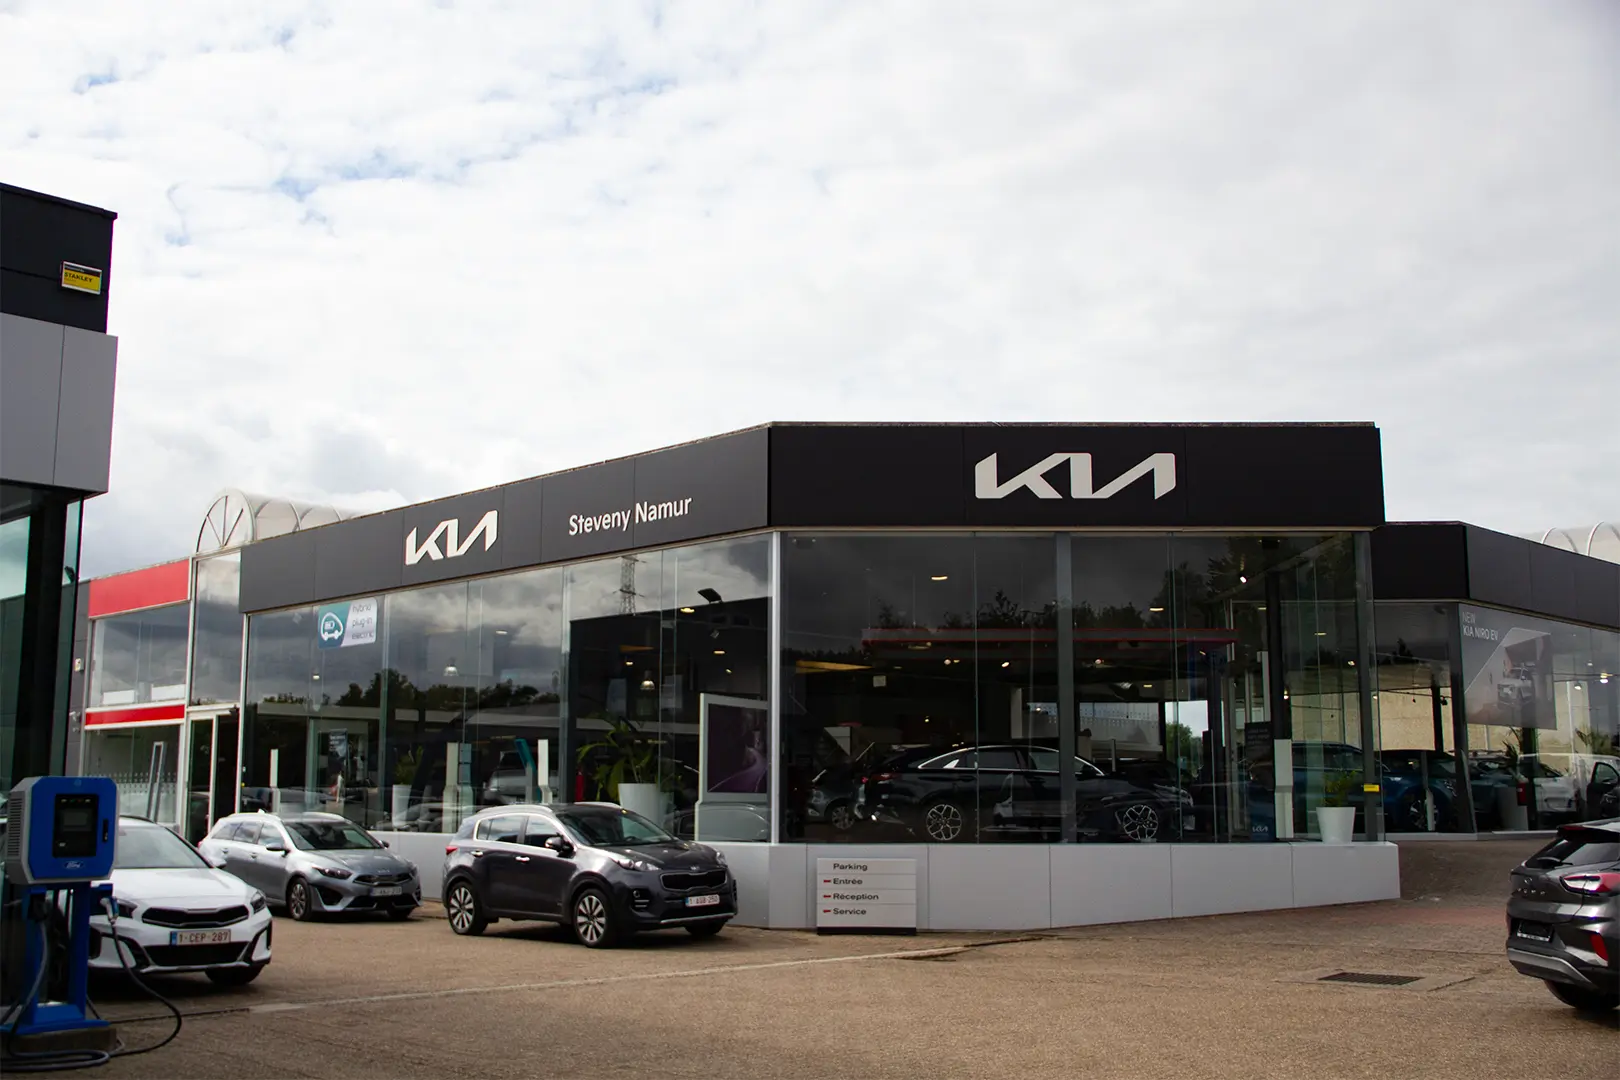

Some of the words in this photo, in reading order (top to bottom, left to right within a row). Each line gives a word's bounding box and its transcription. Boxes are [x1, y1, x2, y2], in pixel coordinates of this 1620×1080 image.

[64, 271, 93, 283] STANLEY
[974, 452, 1176, 500] KIA
[568, 509, 631, 536] Steveny
[635, 497, 692, 524] Namur
[405, 509, 498, 566] KIA
[1462, 611, 1476, 624] NEW
[1463, 625, 1475, 638] KIA
[1474, 627, 1490, 640] NIRO
[1490, 629, 1499, 641] EV
[833, 863, 868, 872] Parking
[833, 877, 863, 885] Entrée
[833, 892, 879, 901] Réception
[833, 907, 867, 915] Service
